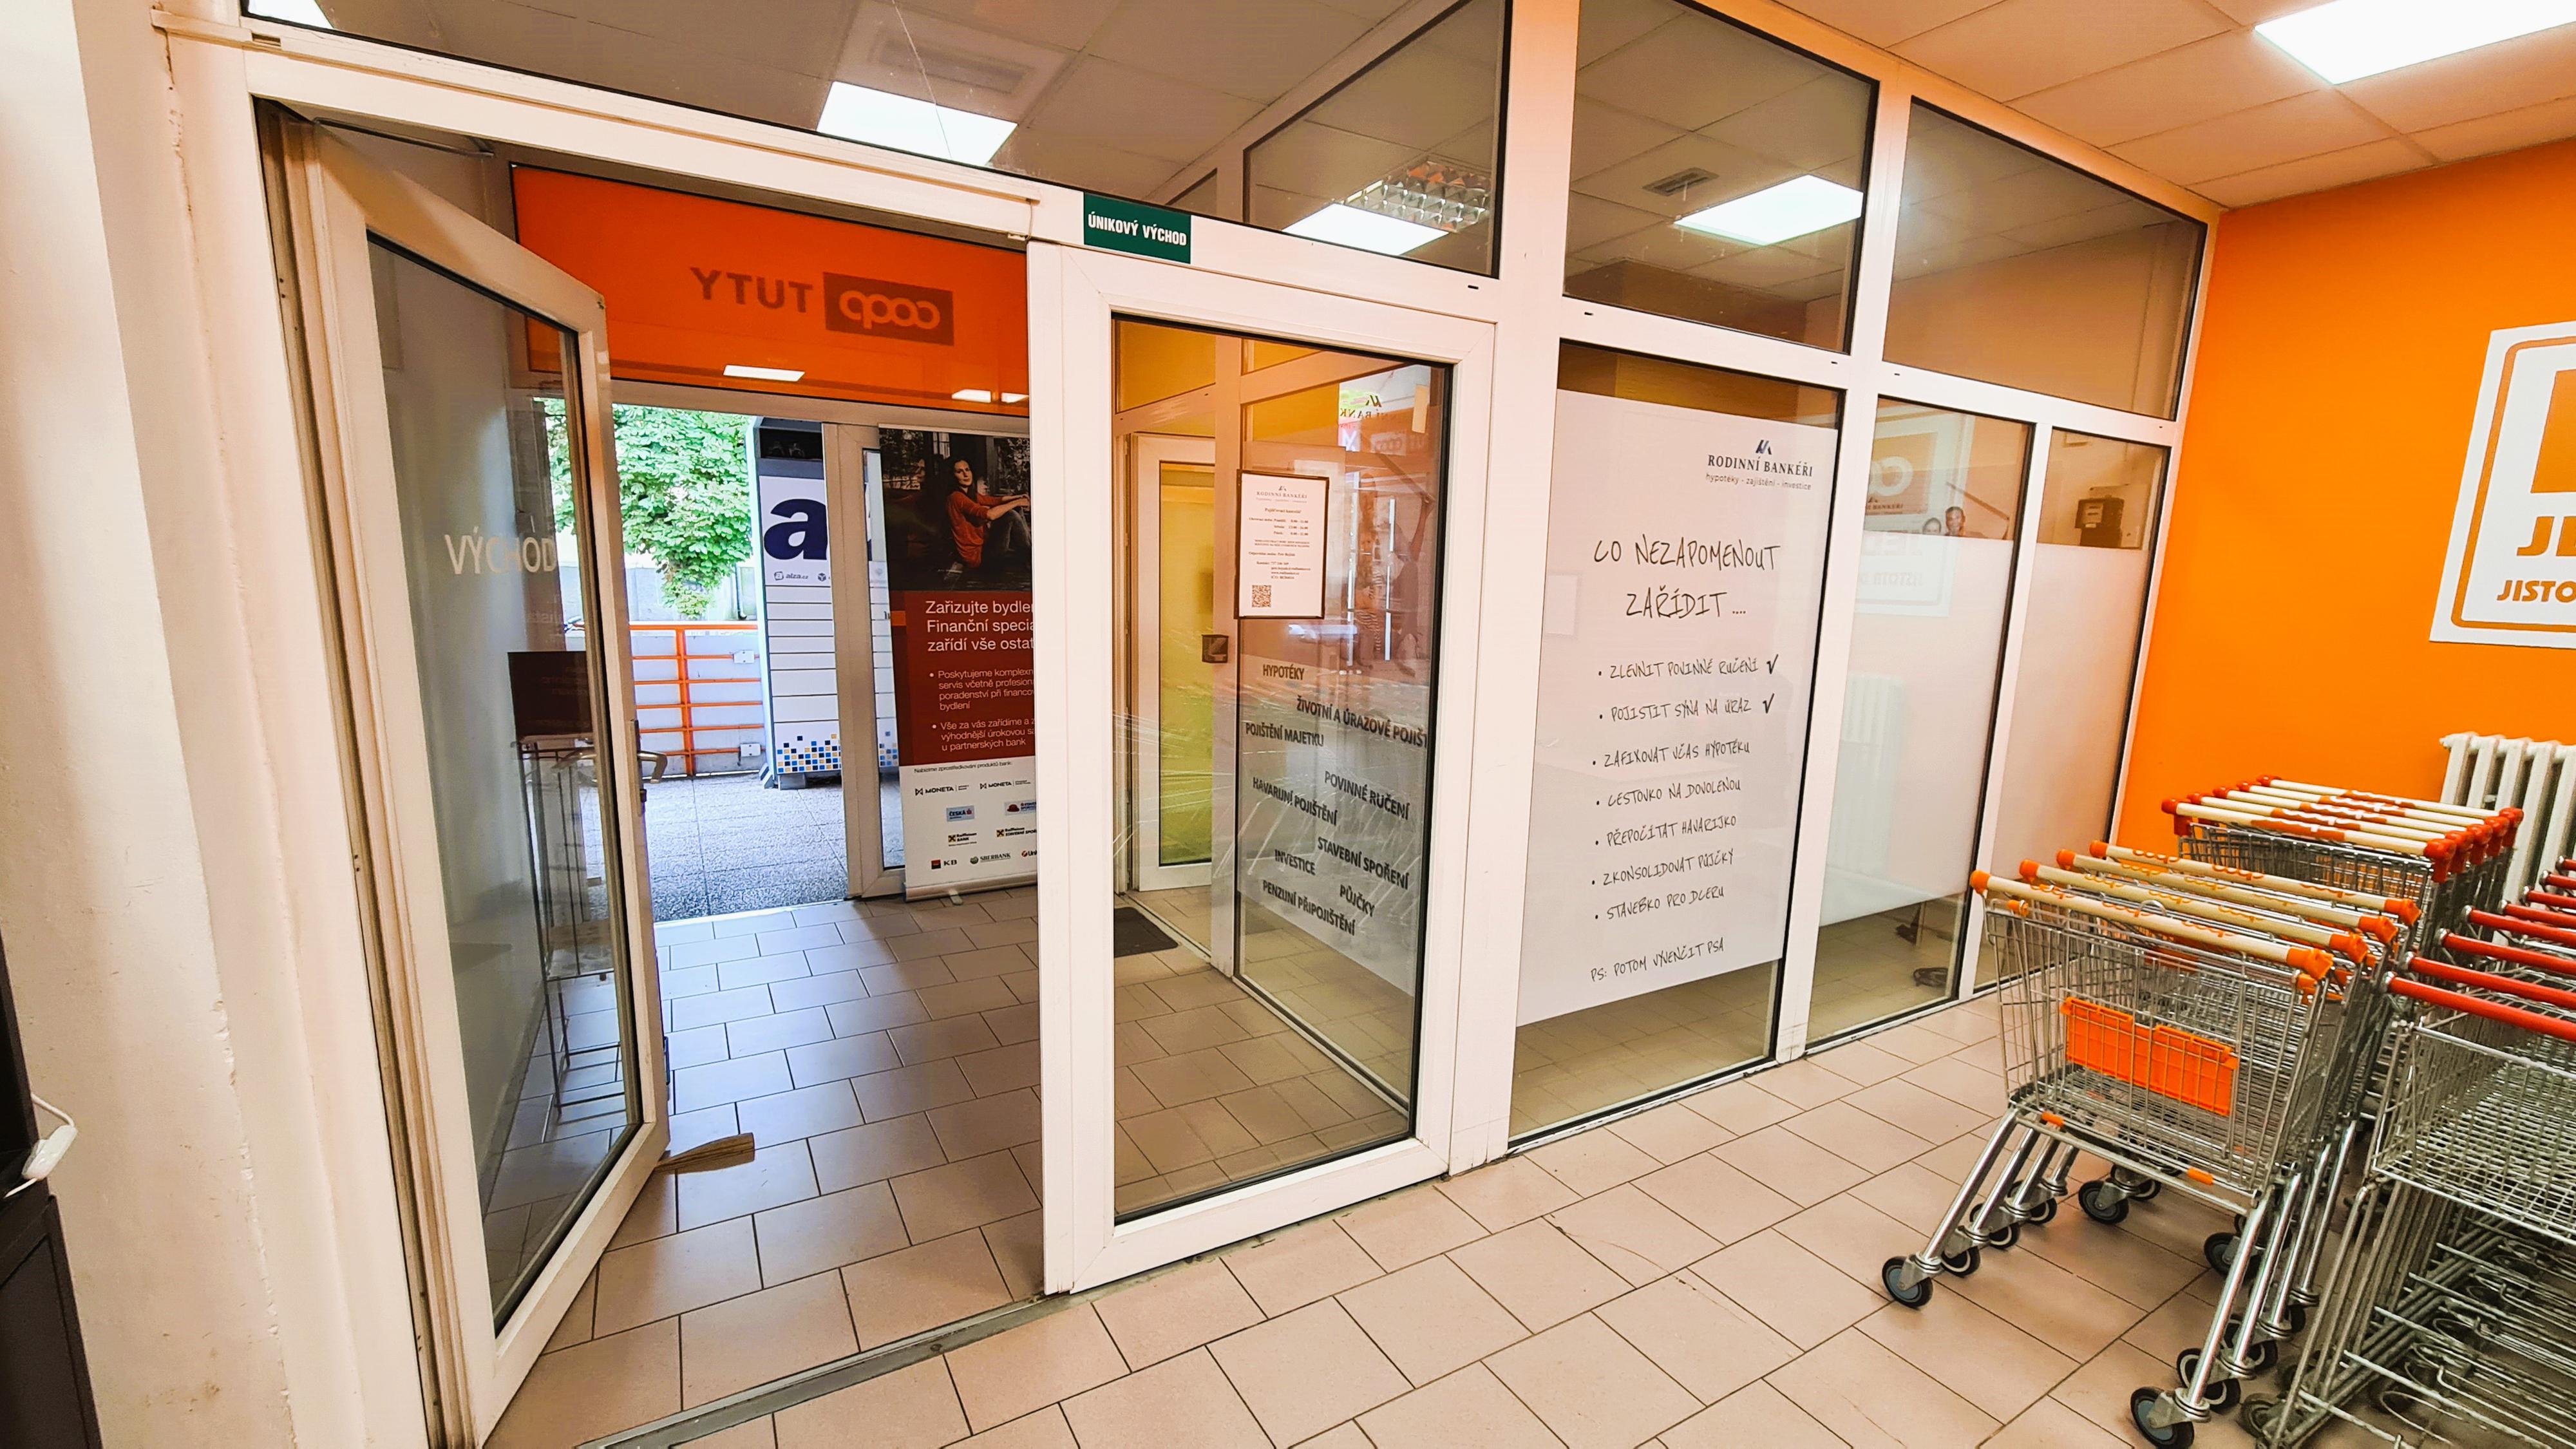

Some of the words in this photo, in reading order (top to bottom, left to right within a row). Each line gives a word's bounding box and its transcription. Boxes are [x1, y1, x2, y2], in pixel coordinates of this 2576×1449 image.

[1088, 211, 1139, 236] ÚNIKOVÝ
[1142, 223, 1187, 246] VÝCHOD
[1707, 455, 1761, 471] RODINNÍ
[1764, 460, 1813, 477] BANKÉŘI
[1705, 473, 1739, 485] hypotéky
[1746, 477, 1776, 487] zajištění
[1781, 479, 1812, 490] investice
[444, 526, 558, 574] VÝCHOD
[1594, 540, 1622, 563] CO
[1635, 534, 1781, 571] NEZAPOMENOUT
[1626, 585, 1728, 619] ZAŘÍDIT
[2497, 580, 2576, 603] JISTO
[925, 600, 989, 616] Zařizujte
[992, 600, 1033, 616] bydle
[927, 618, 989, 633] Finanční
[927, 637, 967, 652] zařídí
[971, 638, 996, 650] vše
[938, 670, 992, 681] Poskytujeme
[1263, 664, 1305, 680] HYPOTÉKY
[1610, 660, 1665, 679] ZLEVNIT
[1668, 658, 1713, 676] POVINNÉ
[1719, 656, 1759, 675] RUČENÍ
[938, 680, 963, 689] servis
[965, 678, 993, 688] včetně
[996, 678, 1034, 688] profesion
[939, 689, 989, 701] poradenství
[1003, 688, 1034, 697] financo
[940, 701, 971, 712] bydlení
[1296, 695, 1332, 721] ŽIVOTNÍ
[1333, 710, 1341, 721] A
[1343, 708, 1391, 739] ÚRAZOVÉ
[1611, 703, 1671, 722] POJISTIT
[1705, 697, 1718, 715] NA
[1725, 697, 1752, 714] ÚRAZ
[940, 721, 957, 730] Vše
[971, 720, 985, 729] vás
[988, 718, 1022, 727] zařídíme
[941, 729, 985, 742] výhodnější
[988, 728, 1025, 738] úrokovou
[1245, 722, 1283, 740] POJIŠTĚNÍ
[1284, 728, 1324, 747] MAJETKU
[950, 739, 1004, 752] partnerských
[1006, 737, 1026, 746] bank
[1604, 746, 1670, 768] ZAFIXOVAT
[1672, 743, 1699, 760] VČAS
[1705, 738, 1750, 758] HYPOTÉKU
[925, 786, 954, 794] MONETA
[1253, 777, 1293, 805] HAVARIJNÍ
[1294, 795, 1338, 826] POJIŠTĚNÍ
[1325, 771, 1368, 802] POVINNÉ
[1370, 790, 1410, 820] RUČENÍ
[1608, 788, 1663, 806] CESTOVKO
[1669, 782, 1681, 799] NA
[1685, 777, 1741, 799] DOVOLENOU
[1607, 822, 1678, 847] PŘEPOČÍTAT
[1681, 815, 1737, 835] HAVARIJKO
[980, 853, 1011, 861] SBERBANK
[1274, 849, 1316, 876] INVESTICE
[1318, 837, 1362, 868] STAVEBNÍ
[1363, 857, 1410, 890] SPOŘENÍ
[1603, 857, 1695, 886] ZKONSOLIDOVAT
[1698, 848, 1734, 869] PŮJČKY
[1263, 880, 1297, 907] PENZIJNÍ
[1298, 896, 1356, 936] PŘIPOJIŠTĚNÍ
[1340, 884, 1375, 918] PŮJČKY
[1607, 896, 1661, 920] STAVEBKO
[1666, 893, 1687, 908] PRO
[1688, 886, 1725, 905] DCERU
[1613, 956, 1647, 977] POTOM
[1653, 943, 1705, 968] VYVENČIT
[1707, 937, 1725, 954] PSA
